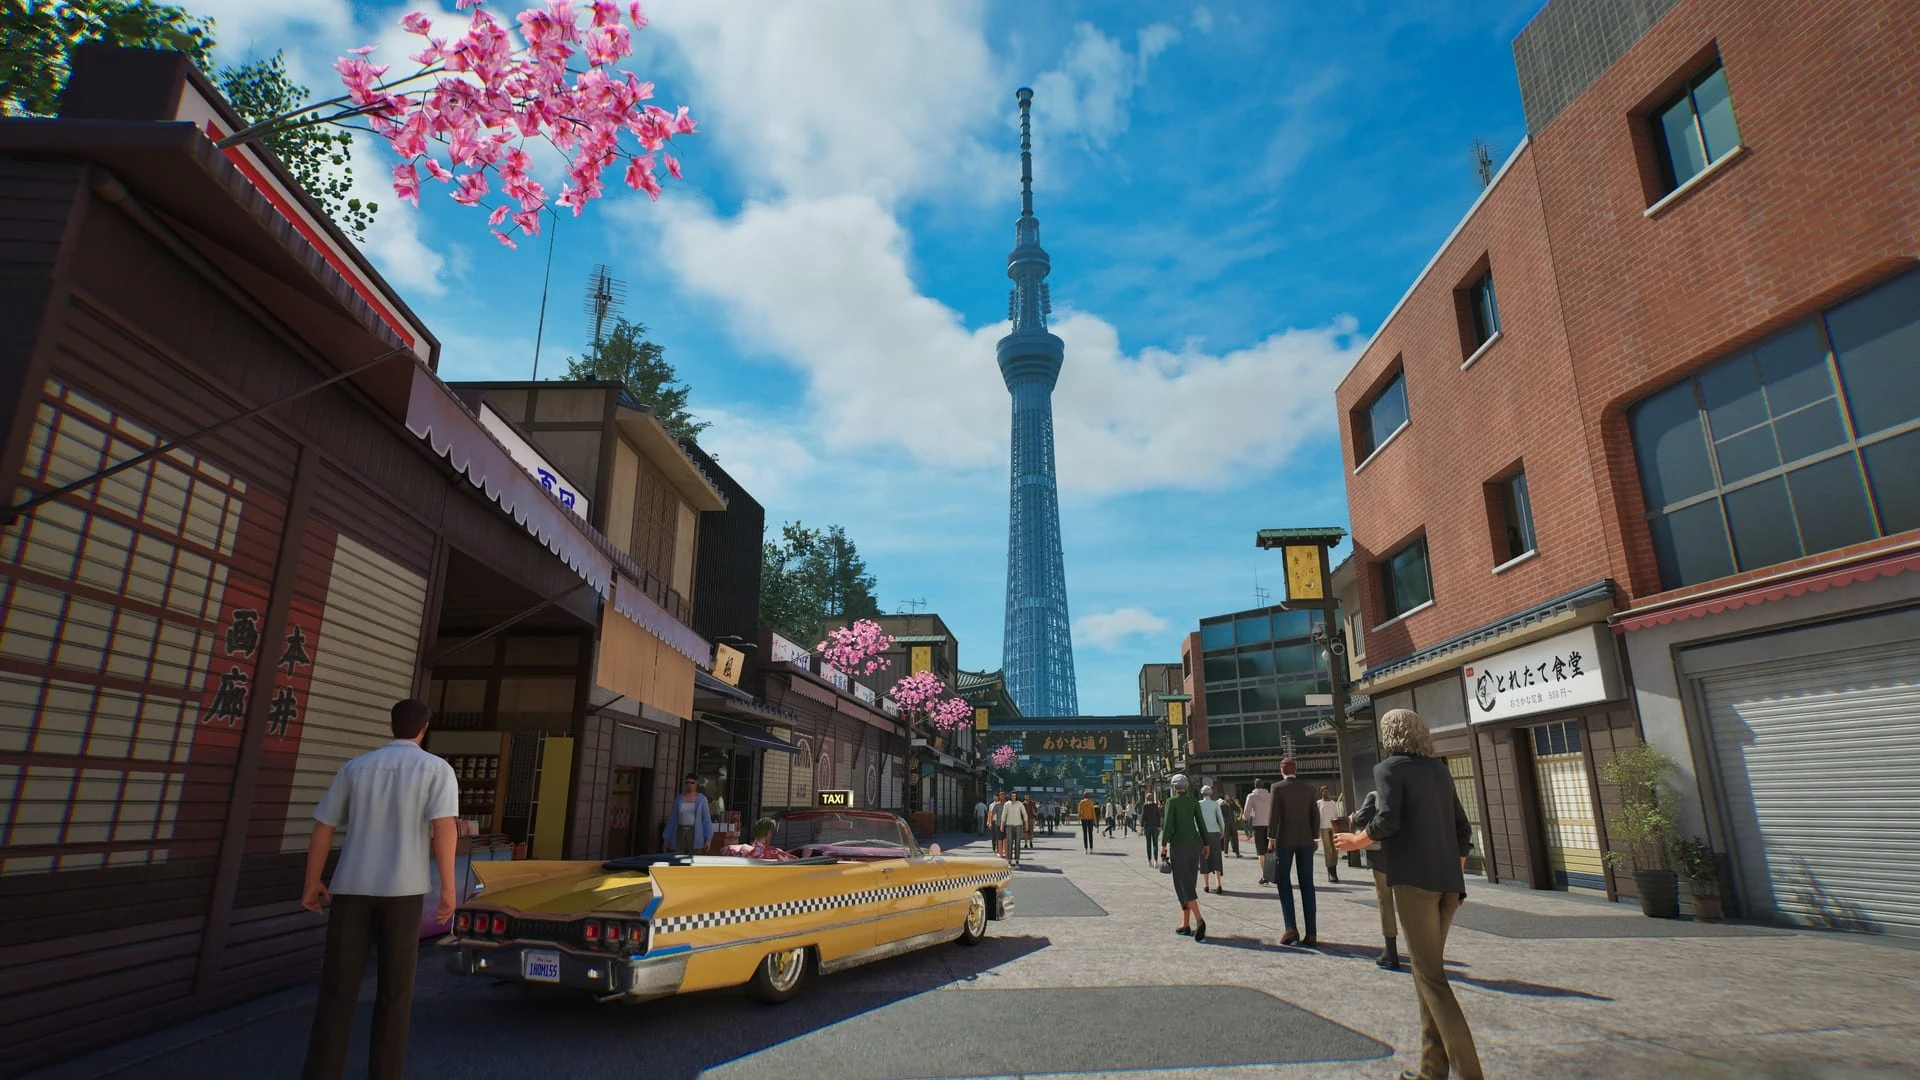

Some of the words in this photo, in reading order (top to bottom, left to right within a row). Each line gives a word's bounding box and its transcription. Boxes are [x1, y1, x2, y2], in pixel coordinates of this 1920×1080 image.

[1495, 651, 1585, 693] とれたて食堂
[1043, 735, 1108, 750] あかね通り
[822, 793, 845, 804] TAXI
